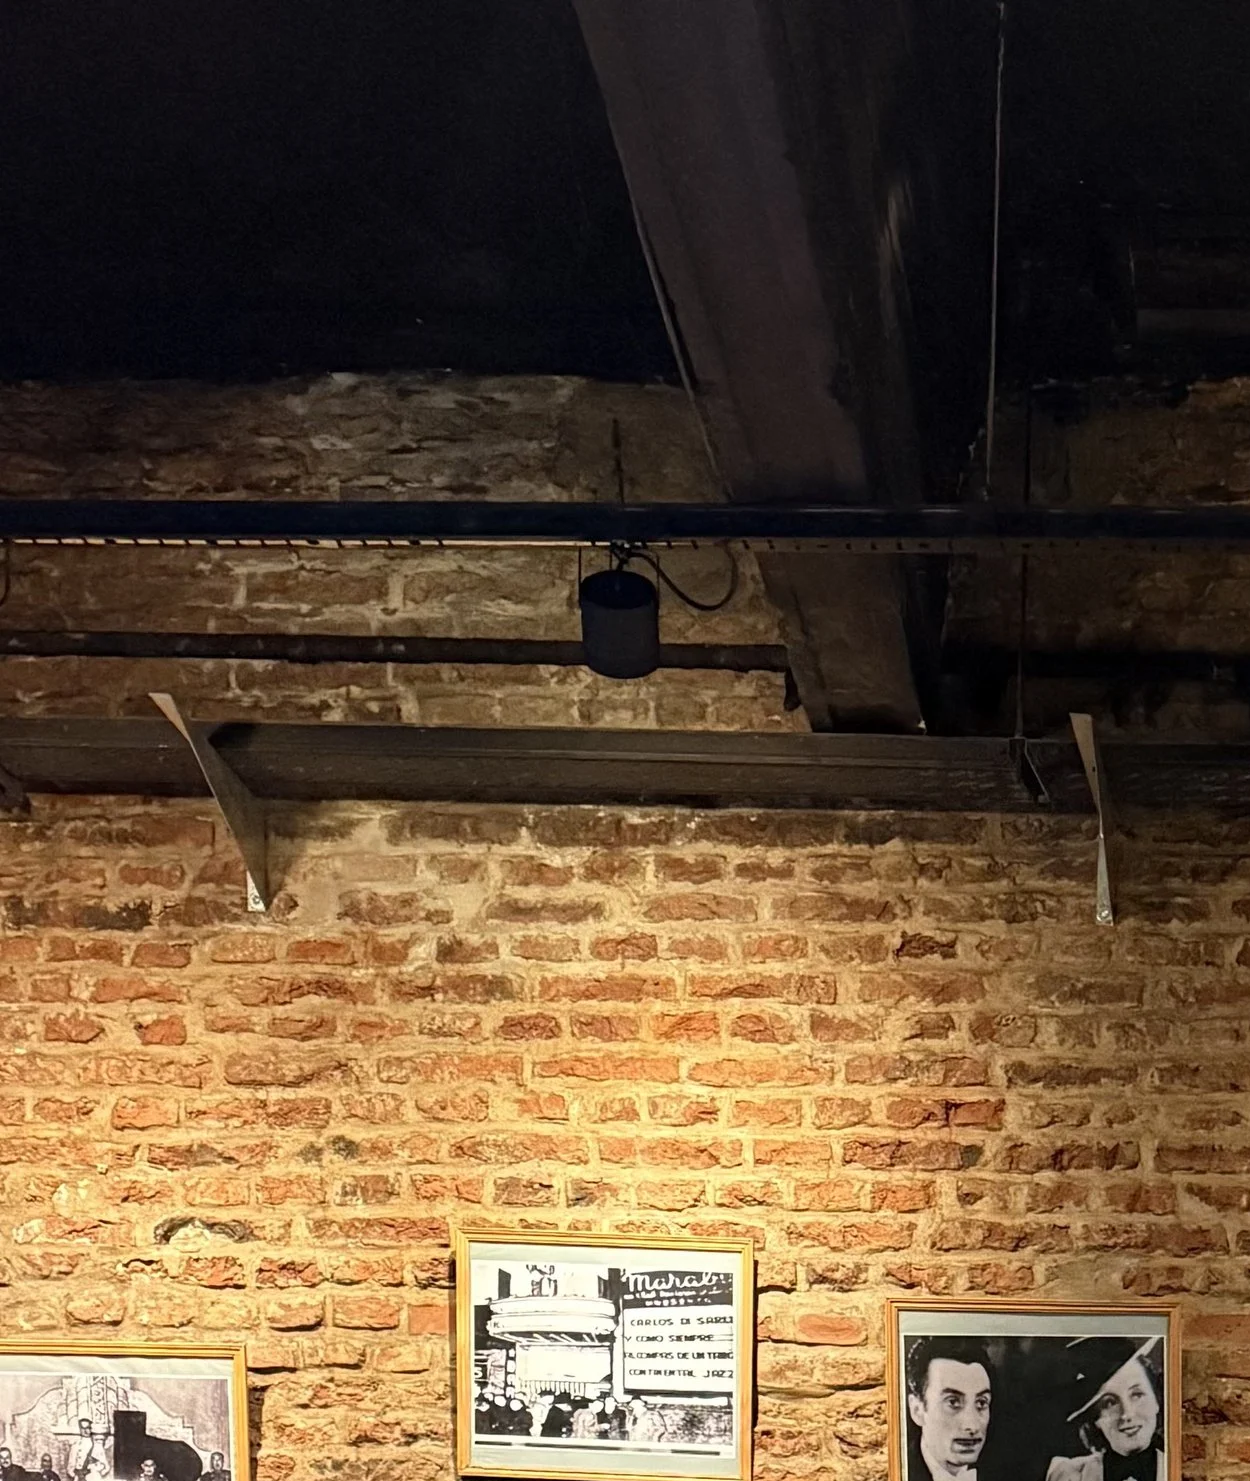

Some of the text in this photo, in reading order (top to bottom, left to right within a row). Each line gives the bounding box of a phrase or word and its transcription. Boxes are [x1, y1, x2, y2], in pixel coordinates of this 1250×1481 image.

[630, 1318, 674, 1326] CARLOS
[680, 1317, 691, 1325] DI
[635, 1335, 664, 1343] COMO
[668, 1334, 714, 1342] SIEMPRE
[677, 1351, 689, 1359] DE
